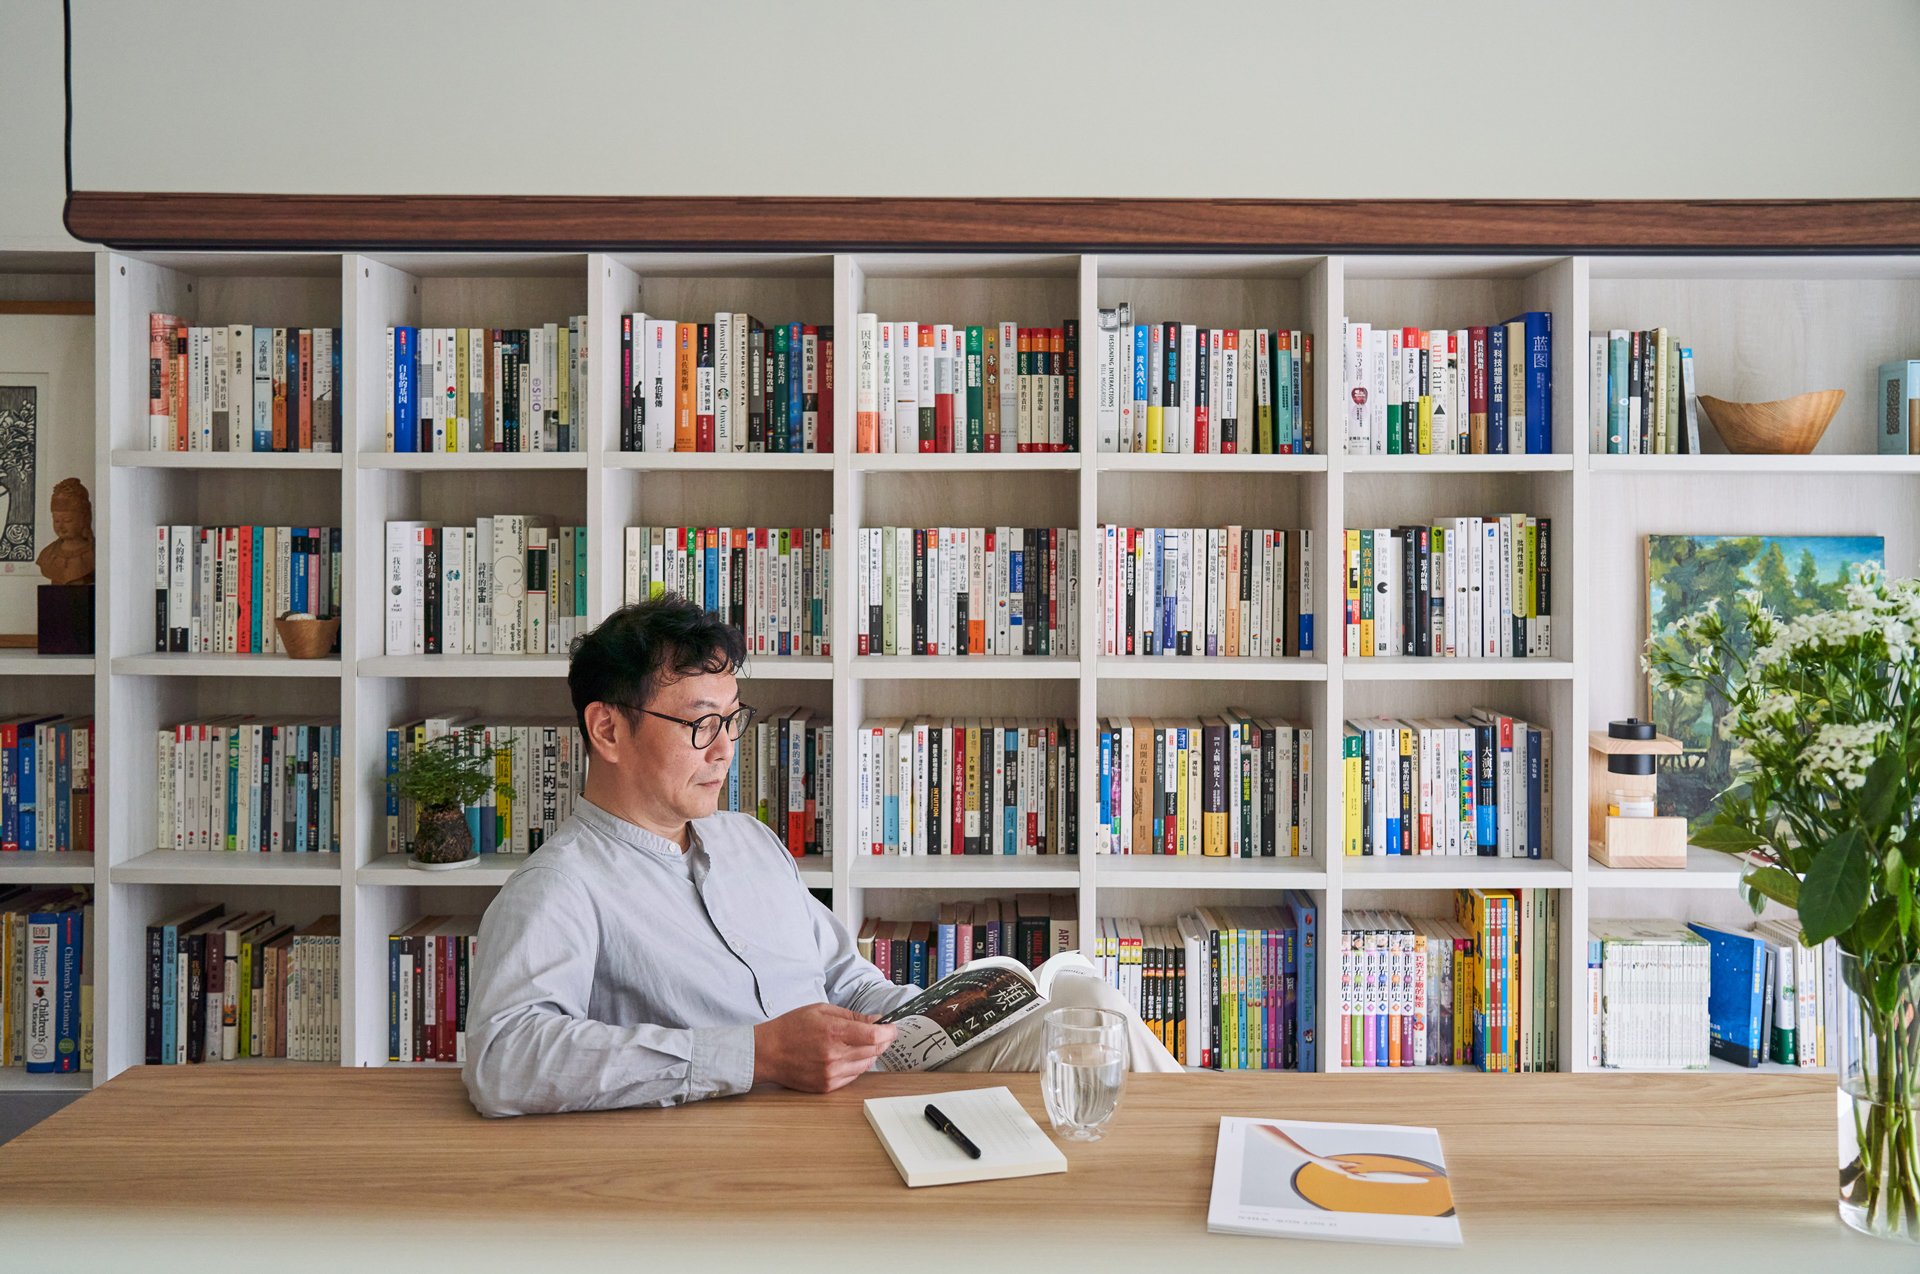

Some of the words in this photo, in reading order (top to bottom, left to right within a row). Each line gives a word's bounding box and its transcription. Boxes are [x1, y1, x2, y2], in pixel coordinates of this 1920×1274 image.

[861, 330, 871, 370] 因果革命
[1533, 336, 1547, 368] 蓝图
[399, 364, 407, 403] 自私的基因
[1260, 359, 1267, 376] 品格
[532, 378, 541, 412] OSHO
[655, 378, 663, 407] 賈伯斯傳
[719, 404, 728, 438] Onward
[176, 539, 184, 572] 人的條件
[1516, 539, 1525, 576] 批判性思考
[477, 561, 487, 604] 詩性的宇宙
[543, 729, 556, 821] T恤上的宇宙
[1481, 746, 1493, 779] 大演算
[1059, 929, 1069, 945] ART
[64, 946, 74, 989] Children's
[911, 961, 920, 985] DEAR
[1415, 955, 1425, 1008] 巧克力工廠的秘密
[991, 981, 1032, 1011] 類
[31, 1002, 39, 1038] Dictionary
[38, 998, 50, 1043] Children's
[62, 990, 73, 1037] Dictionary
[912, 1030, 947, 1062] 代
